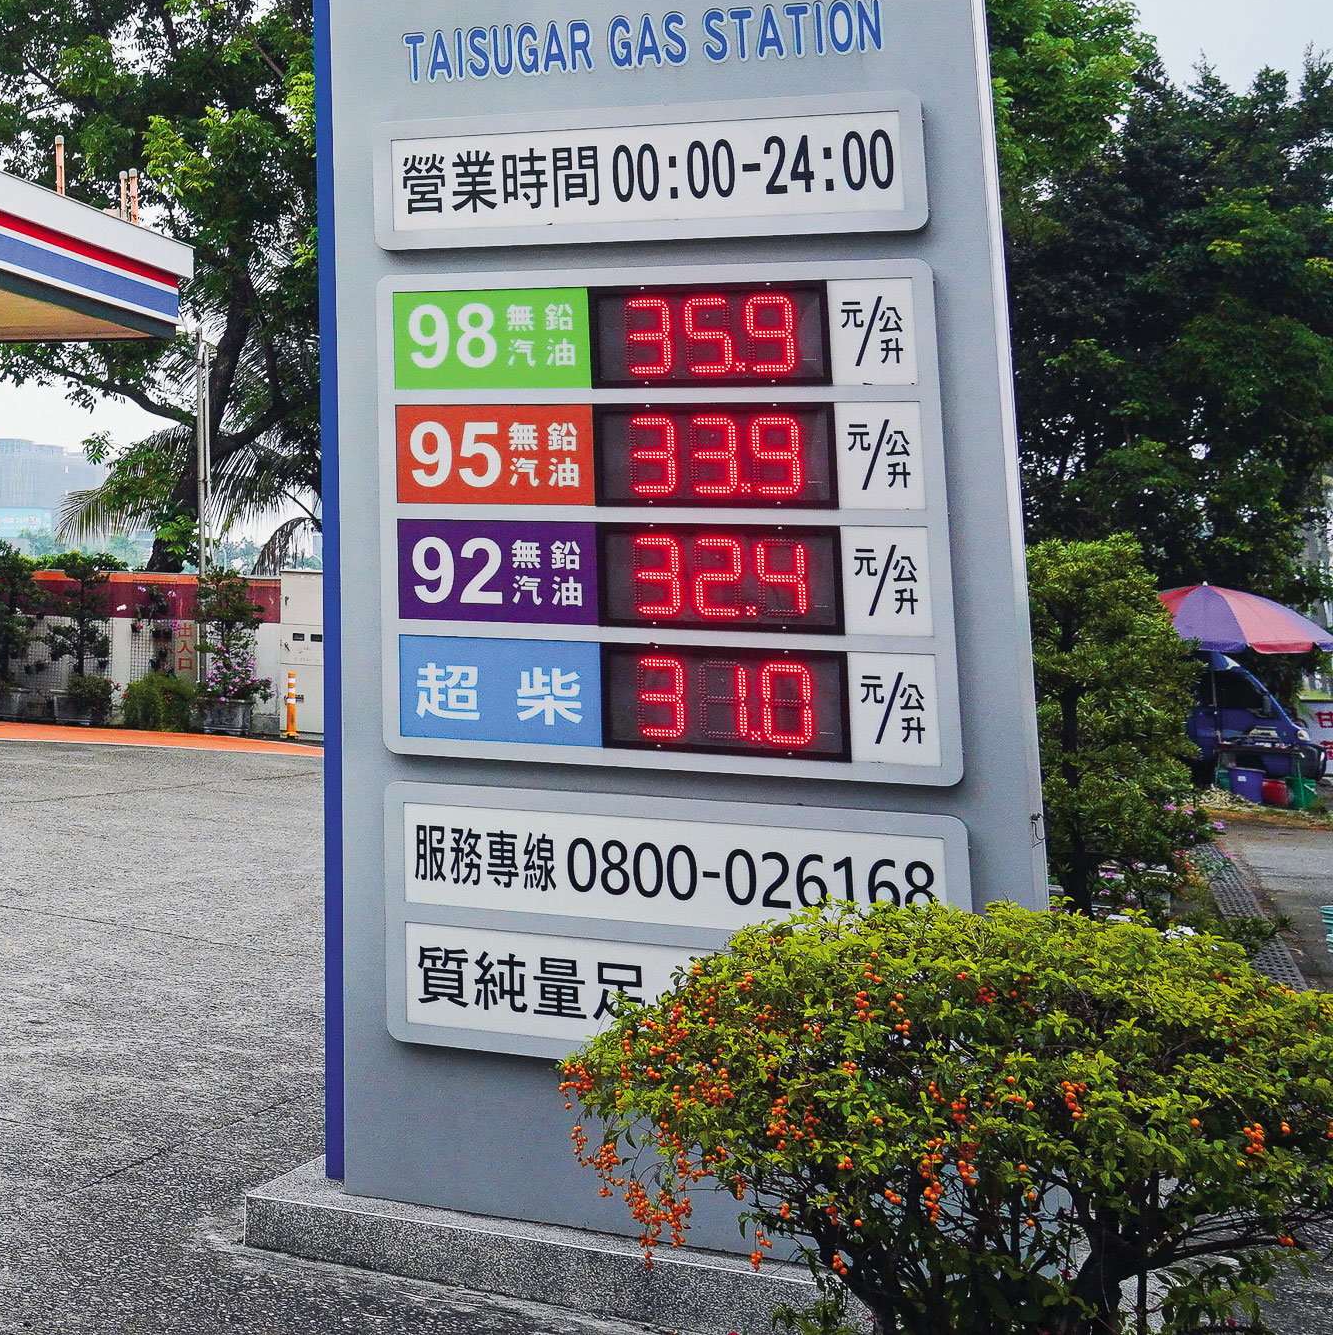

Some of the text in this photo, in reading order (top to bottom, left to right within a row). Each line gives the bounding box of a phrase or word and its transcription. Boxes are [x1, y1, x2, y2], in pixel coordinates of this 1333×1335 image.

[402, 19, 593, 84] TAISUGAR
[608, 10, 688, 68] GAS
[408, 302, 498, 369] 98
[507, 303, 574, 332] 無鉛
[625, 295, 796, 375] 35.9
[507, 337, 577, 367] 汽油
[409, 420, 502, 488] 95
[508, 422, 578, 452] 無鉛
[630, 415, 800, 495] 33.9
[509, 457, 580, 488] 汽油
[411, 536, 503, 605] 92
[511, 539, 581, 571] 無鉛
[634, 536, 808, 617] 32.4
[511, 575, 583, 608] 汽油
[178, 623, 193, 671] 出入口
[416, 662, 583, 727] 超柴
[638, 656, 813, 745] 31.0
[414, 824, 556, 893] 服務專線
[417, 946, 645, 1020] 質純量足
